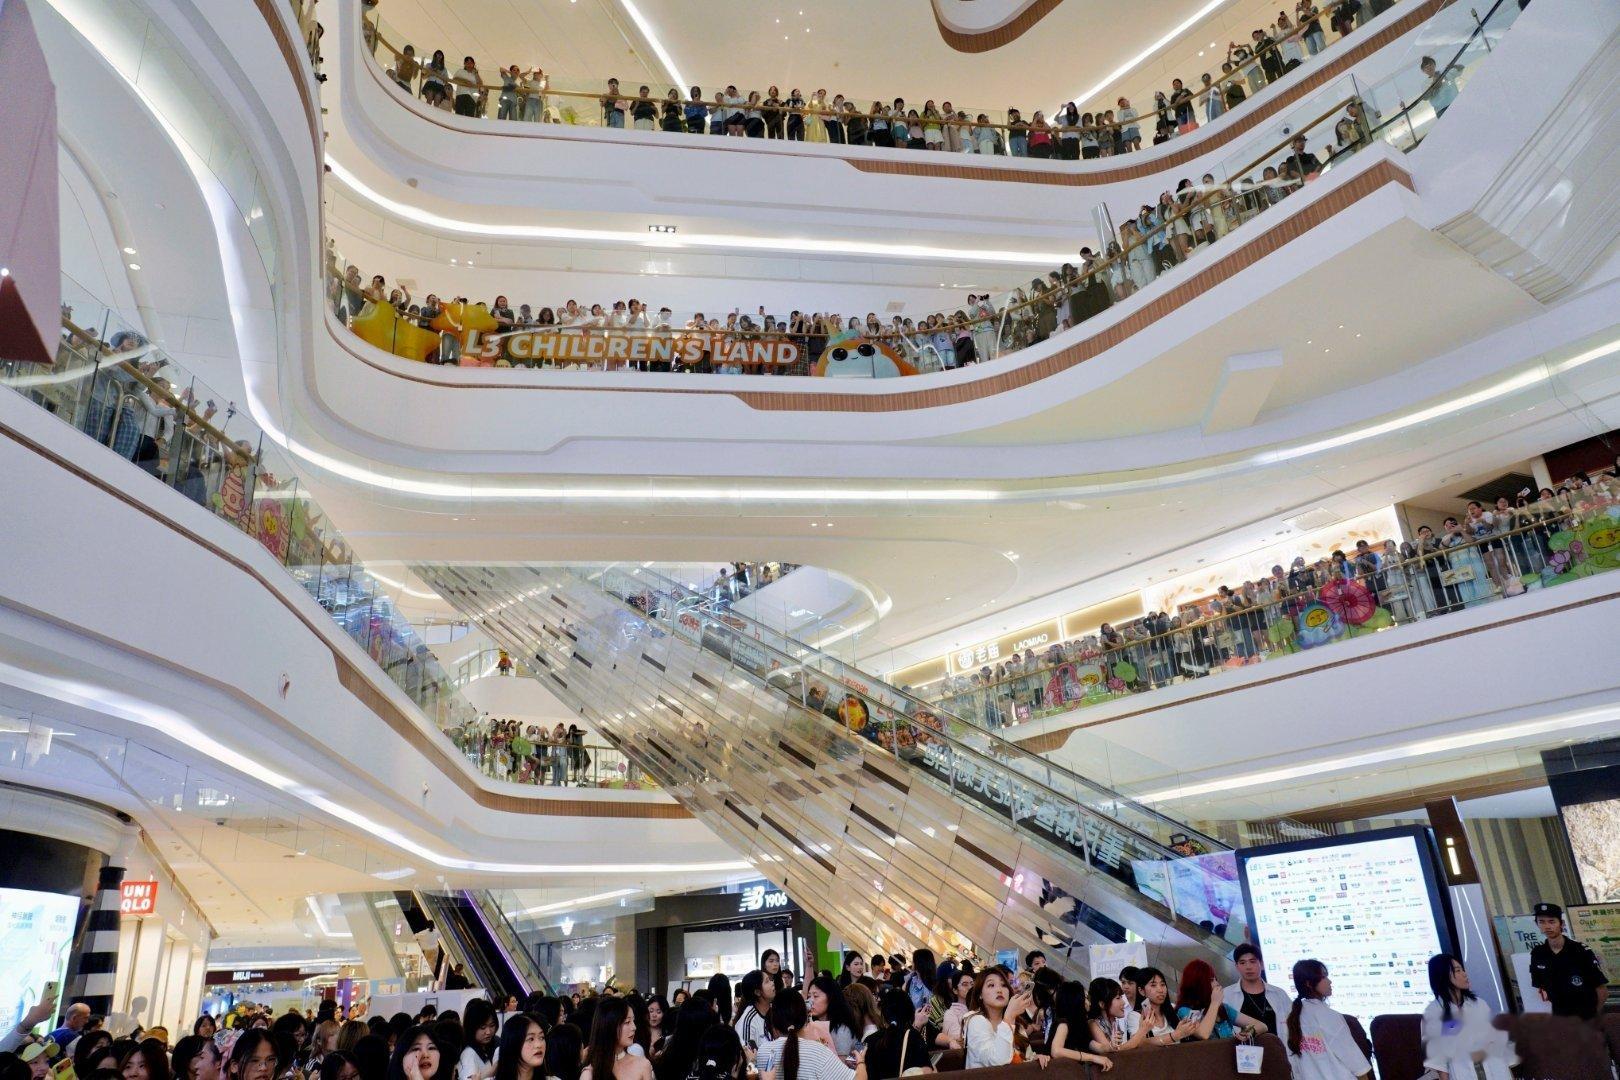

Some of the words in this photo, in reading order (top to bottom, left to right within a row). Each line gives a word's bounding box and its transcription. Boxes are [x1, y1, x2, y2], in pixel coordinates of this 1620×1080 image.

[465, 329, 500, 358] L3
[510, 334, 702, 362] CHILDREN'S
[713, 341, 798, 364] LAND
[1013, 633, 1048, 652] LAOMIAO
[123, 885, 151, 898] UNI
[121, 898, 151, 912] QLO
[765, 892, 788, 908] 1906
[1514, 930, 1538, 942] TRE
